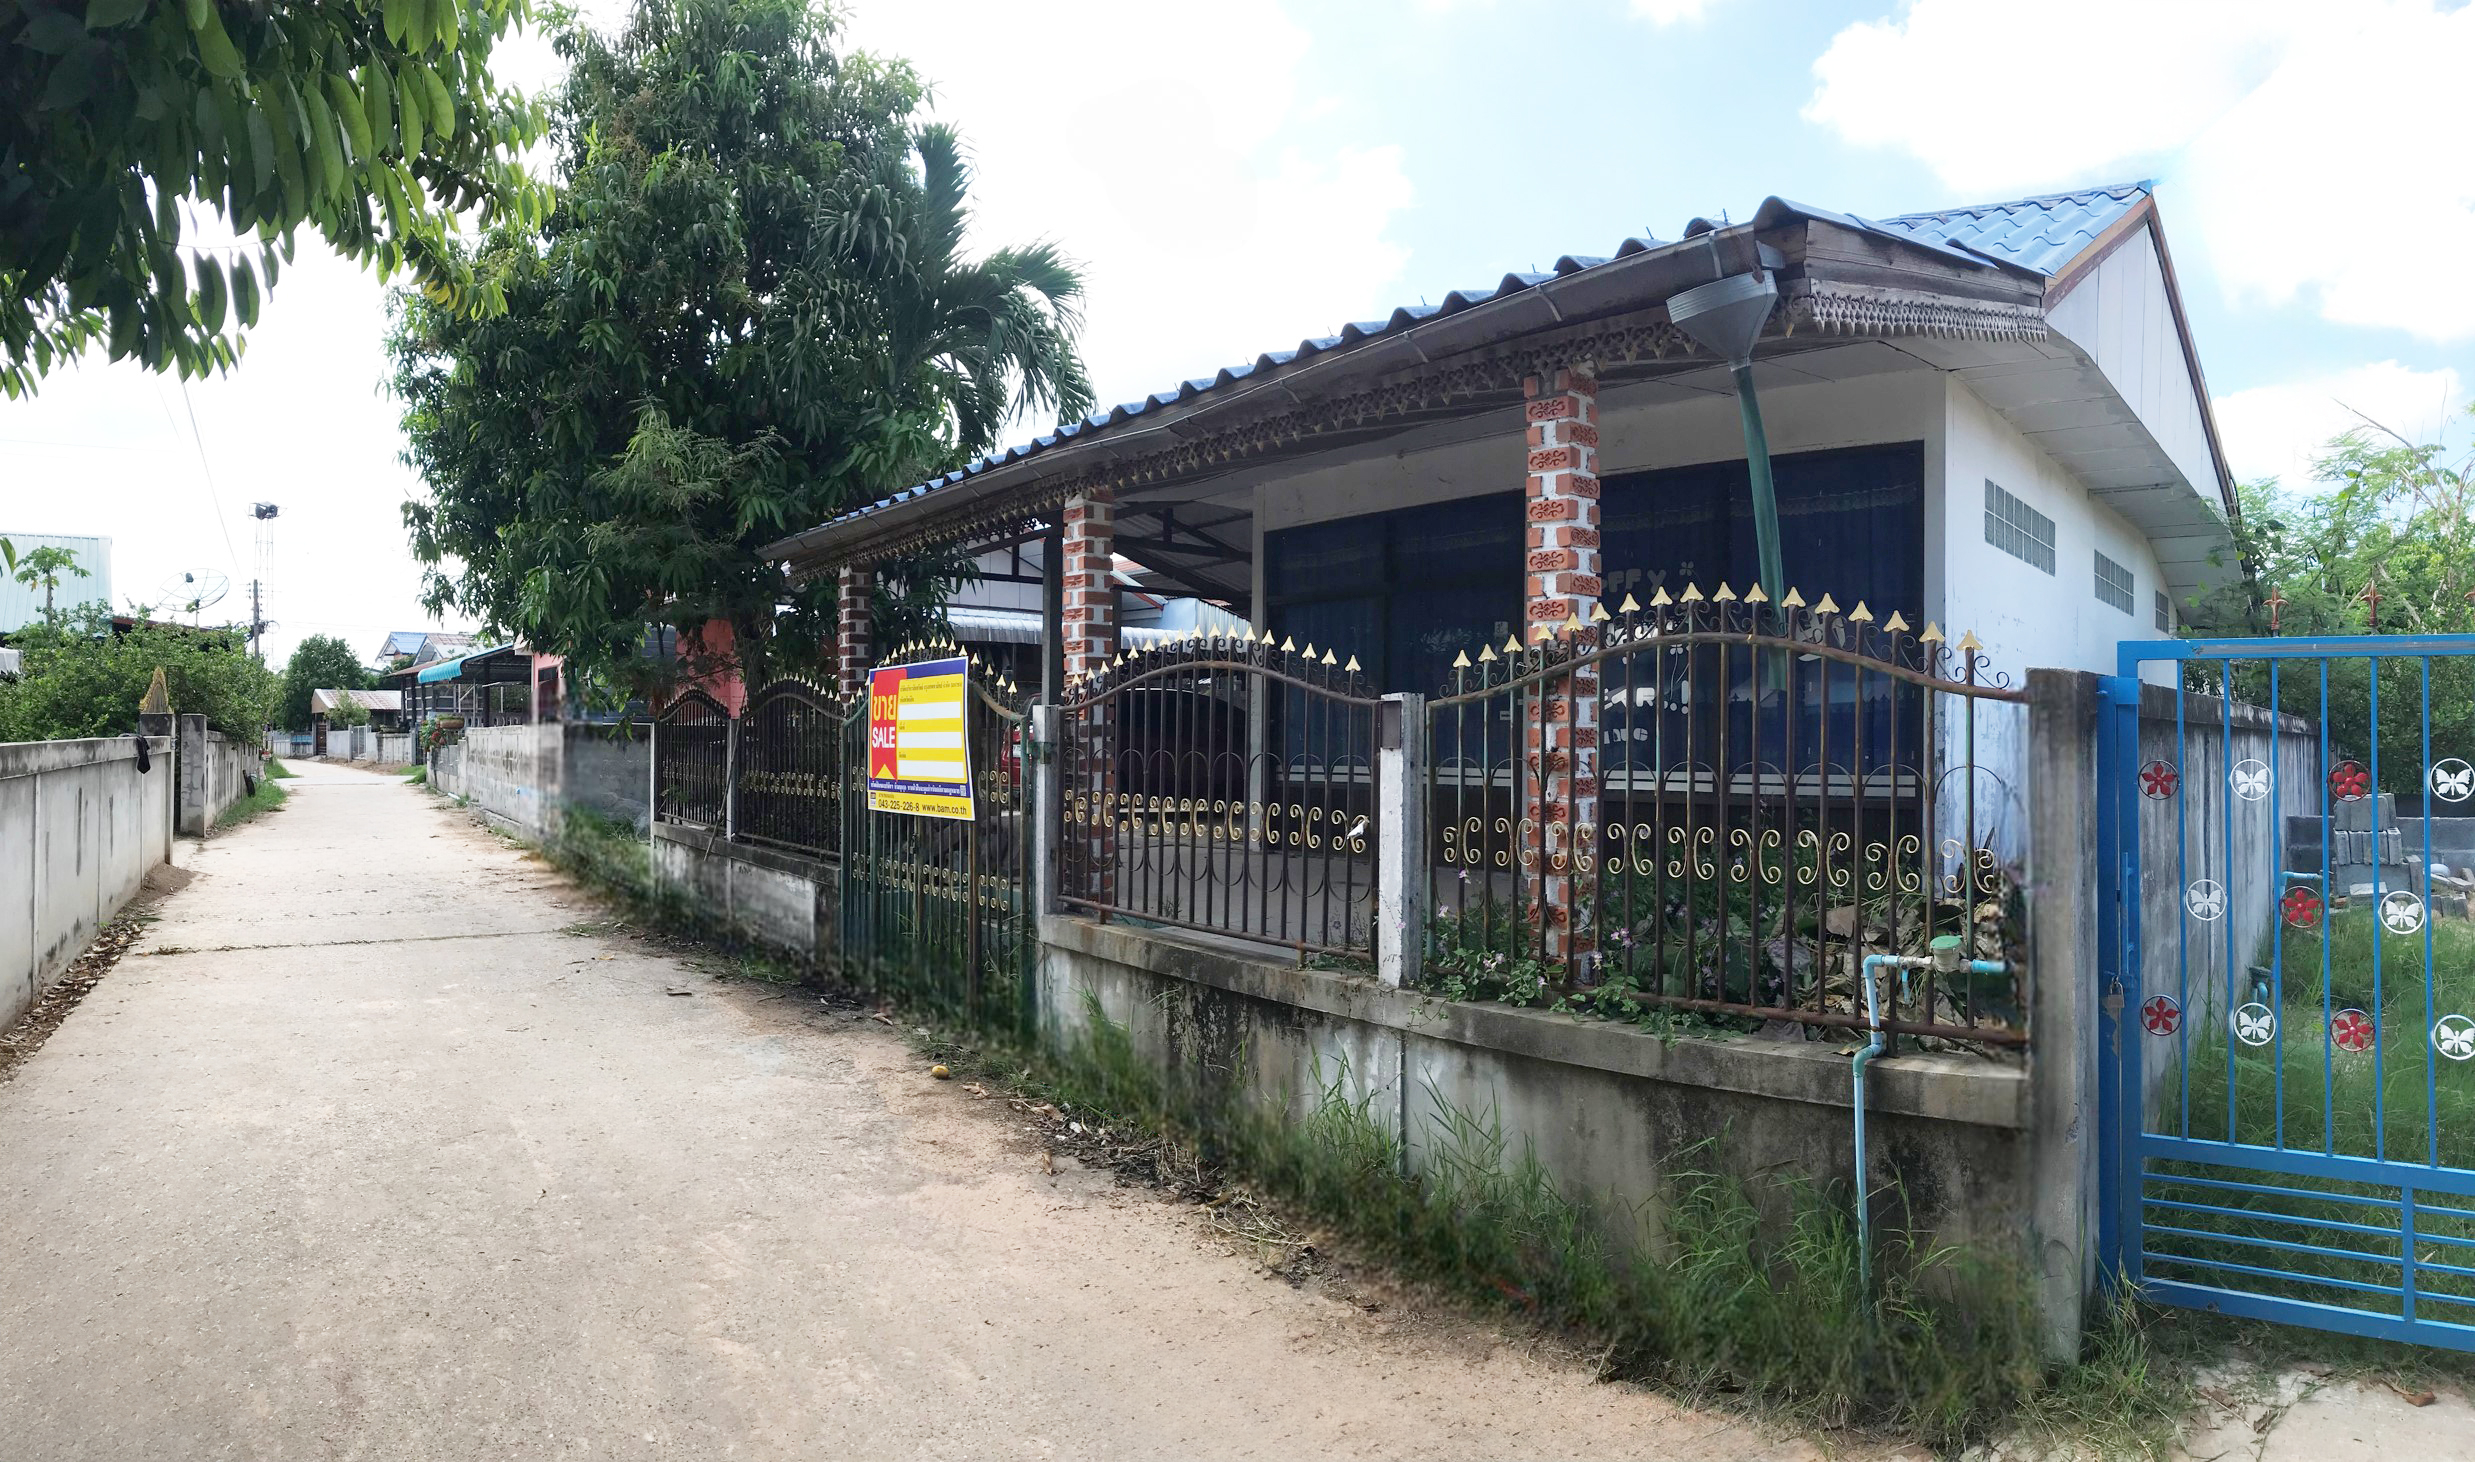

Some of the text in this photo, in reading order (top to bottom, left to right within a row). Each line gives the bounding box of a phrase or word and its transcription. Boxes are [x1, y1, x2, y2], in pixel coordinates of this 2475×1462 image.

[873, 694, 897, 721] ขาย
[872, 726, 896, 749] SALE
[922, 803, 967, 815] www.bam.co.th
